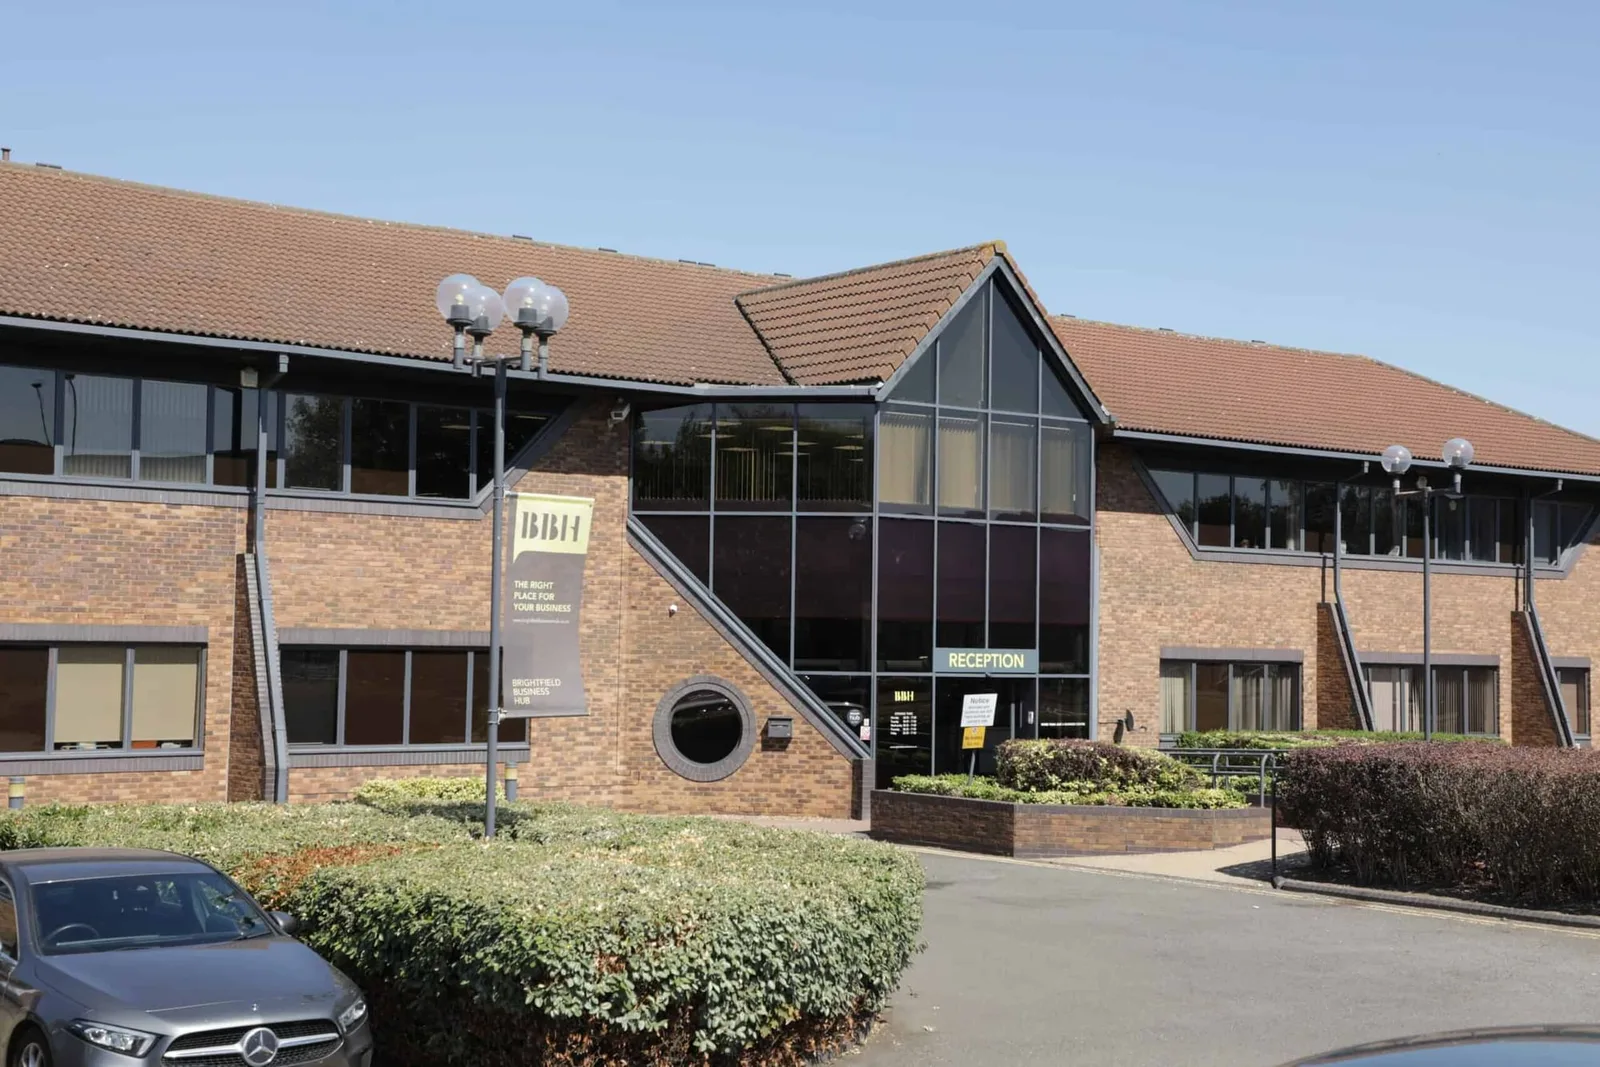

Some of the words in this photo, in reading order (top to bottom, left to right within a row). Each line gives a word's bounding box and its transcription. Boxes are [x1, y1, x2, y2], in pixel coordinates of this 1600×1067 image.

[521, 511, 580, 542] BBH
[514, 580, 529, 589] THE
[530, 581, 554, 590] RIGHT
[513, 592, 537, 601] PLACE
[538, 593, 555, 601] FOR
[513, 603, 534, 612] YOUR
[535, 604, 571, 613] BUSINESS
[948, 652, 1025, 669] RECEPTION
[512, 679, 561, 687] BRIGHTFIELD
[512, 688, 550, 696] BUSINESS
[514, 697, 531, 705] HUB
